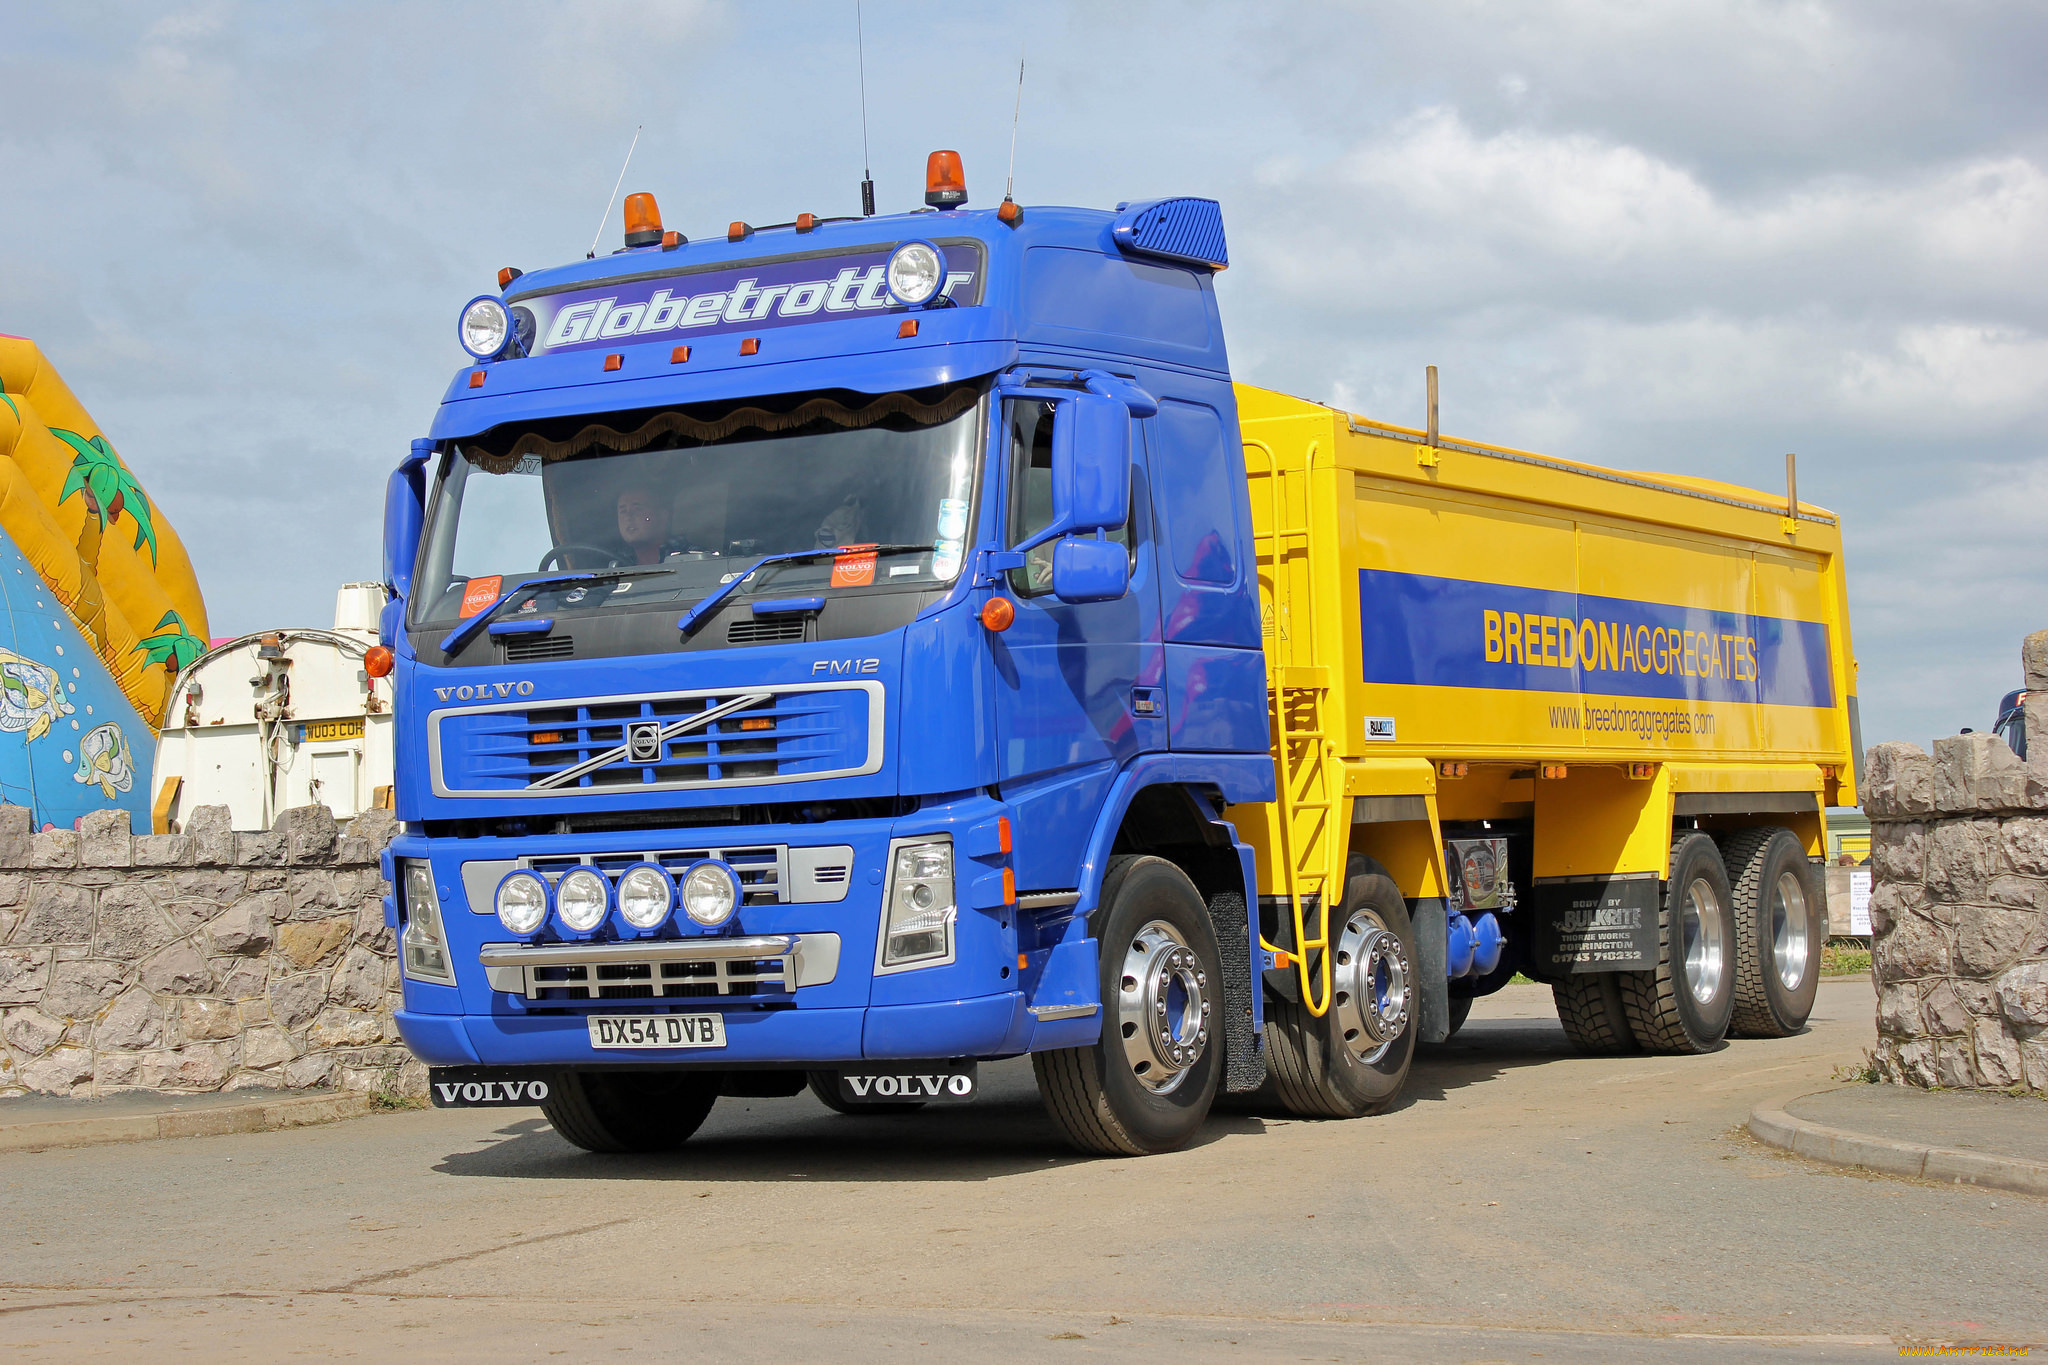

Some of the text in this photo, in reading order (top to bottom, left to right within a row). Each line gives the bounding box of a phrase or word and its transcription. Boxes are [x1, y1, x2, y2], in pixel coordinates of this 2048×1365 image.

[466, 593, 495, 602] VOLVO
[811, 657, 881, 677] FM12
[434, 680, 535, 703] VOLVO
[1548, 699, 1716, 740] www.breedonaggregatescom
[632, 738, 657, 746] VOLVO
[1572, 898, 1621, 909] BODY BY
[1559, 941, 1634, 952] DORRINGTON
[1561, 932, 1631, 942] THORNE WORKS
[598, 1017, 715, 1043] DX54 DVB
[435, 1080, 549, 1102] VOLVO
[844, 1074, 972, 1096] VOLVO
